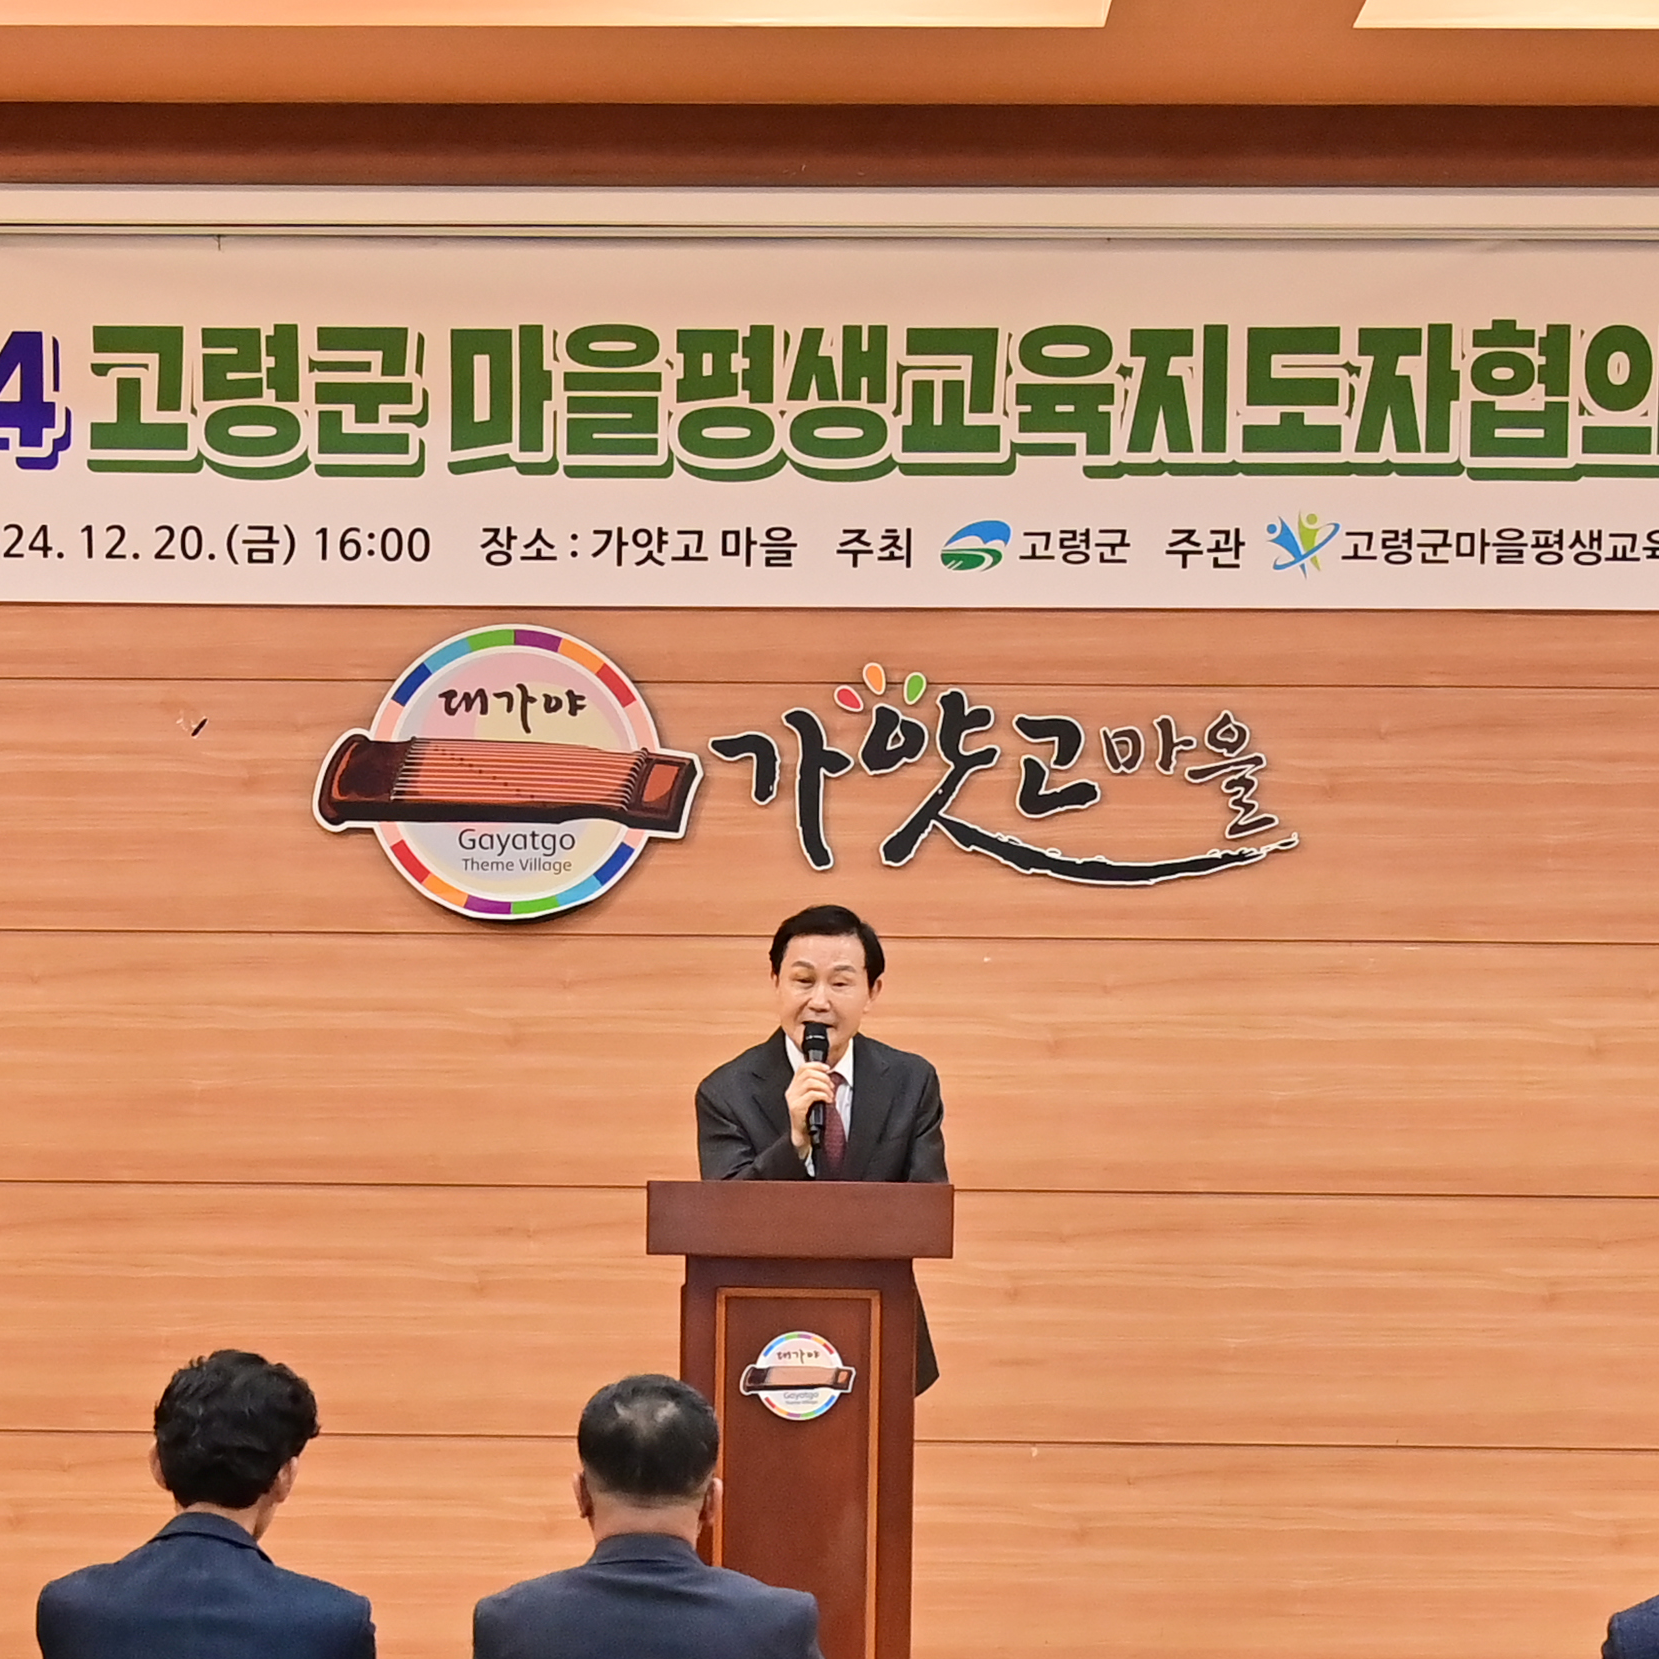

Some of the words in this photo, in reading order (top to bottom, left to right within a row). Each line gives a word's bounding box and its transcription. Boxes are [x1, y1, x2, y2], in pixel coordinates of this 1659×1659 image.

[88, 323, 429, 479] 고령군
[80, 524, 140, 560] 12.
[315, 527, 430, 562] 16:00
[480, 525, 558, 567] 장소
[591, 526, 709, 567] 가얏고
[721, 526, 798, 568] 마을
[836, 527, 912, 569] 주최
[1018, 527, 1131, 565] 고령군
[1165, 527, 1246, 570] 주관
[439, 682, 587, 735] 대가야
[458, 828, 576, 857] Gayatgo
[462, 858, 515, 872] Theme
[519, 858, 572, 875] Village
[776, 1348, 820, 1364] 대가야
